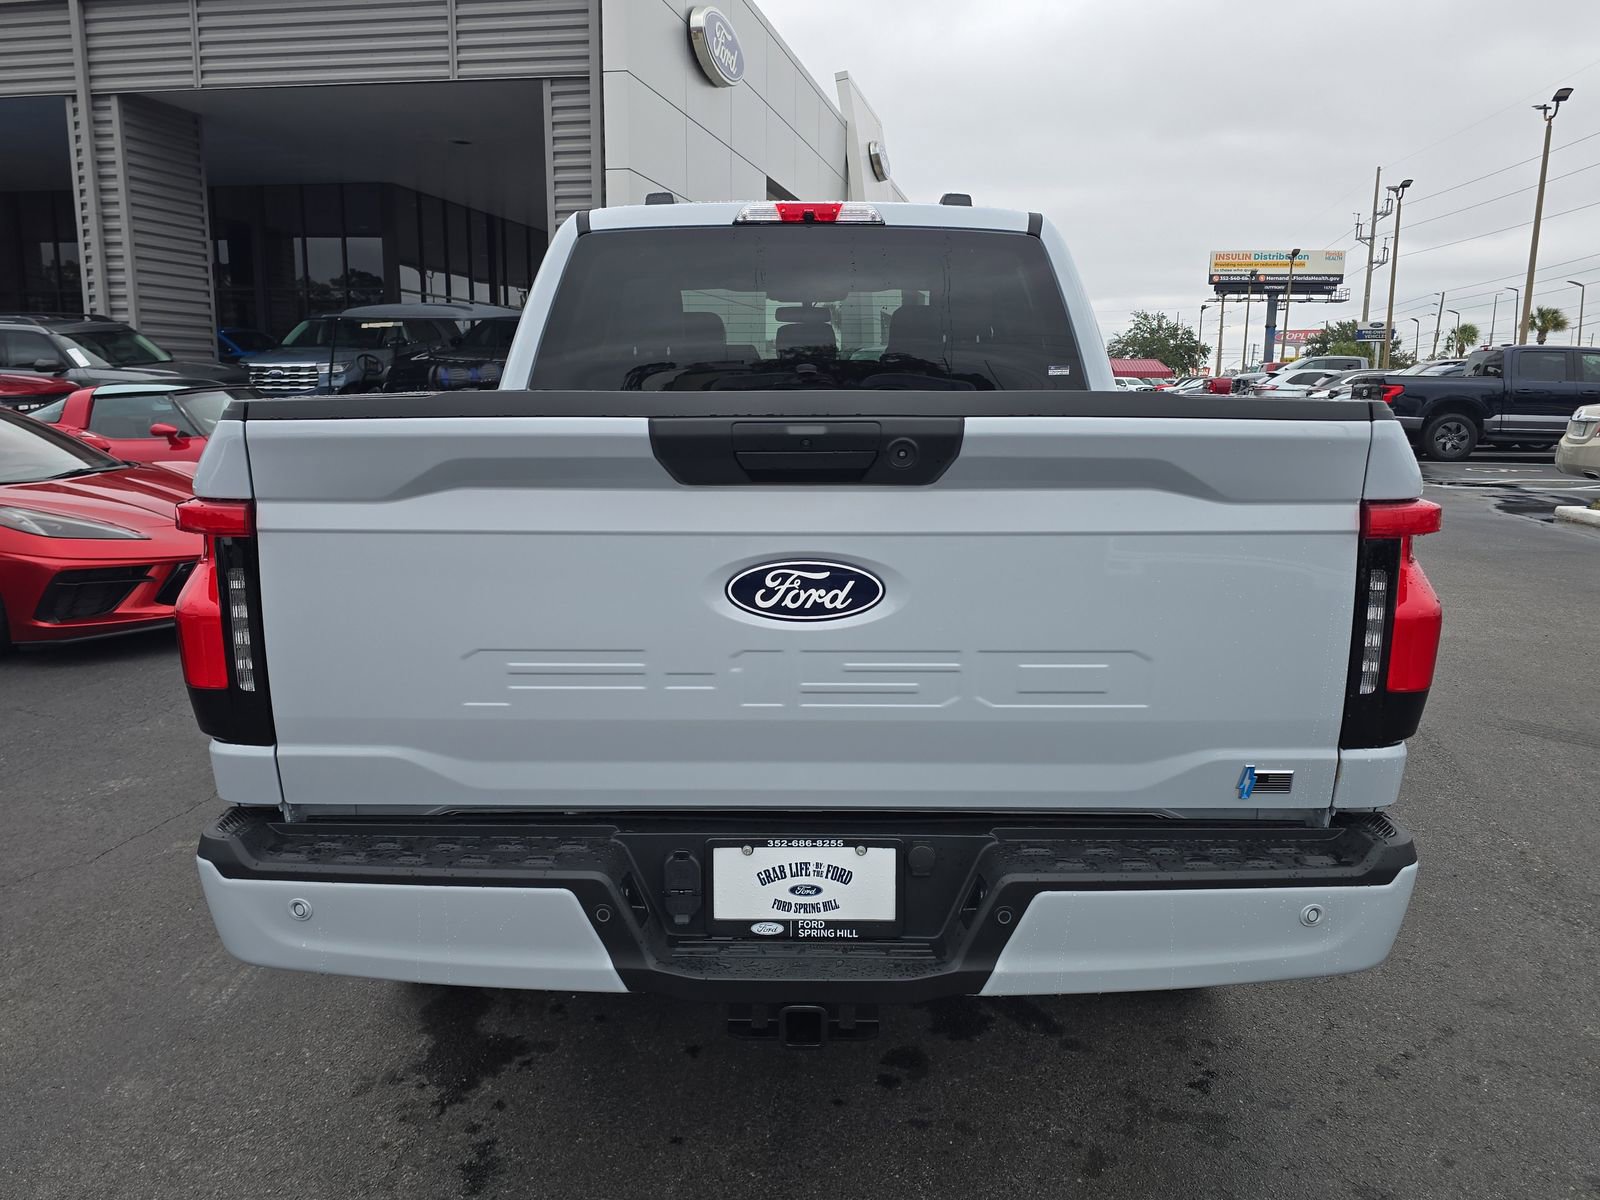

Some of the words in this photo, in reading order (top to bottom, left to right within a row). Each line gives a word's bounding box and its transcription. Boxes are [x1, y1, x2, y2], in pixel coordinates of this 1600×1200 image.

[713, 21, 738, 74] Ford
[1215, 253, 1252, 261] INSULIN
[1253, 252, 1310, 261] Distribon
[754, 569, 856, 609] Ford
[767, 839, 844, 847] 352-686-8255
[756, 864, 788, 887] GRAB
[789, 861, 811, 879] LIFE
[812, 869, 824, 878] THE
[825, 864, 853, 886] FORD
[771, 898, 793, 914] FORD
[793, 902, 821, 914] SPRING
[822, 899, 840, 912] HILL
[798, 920, 825, 928] FORD
[798, 929, 835, 938] SPRING
[836, 929, 859, 938] HILL
